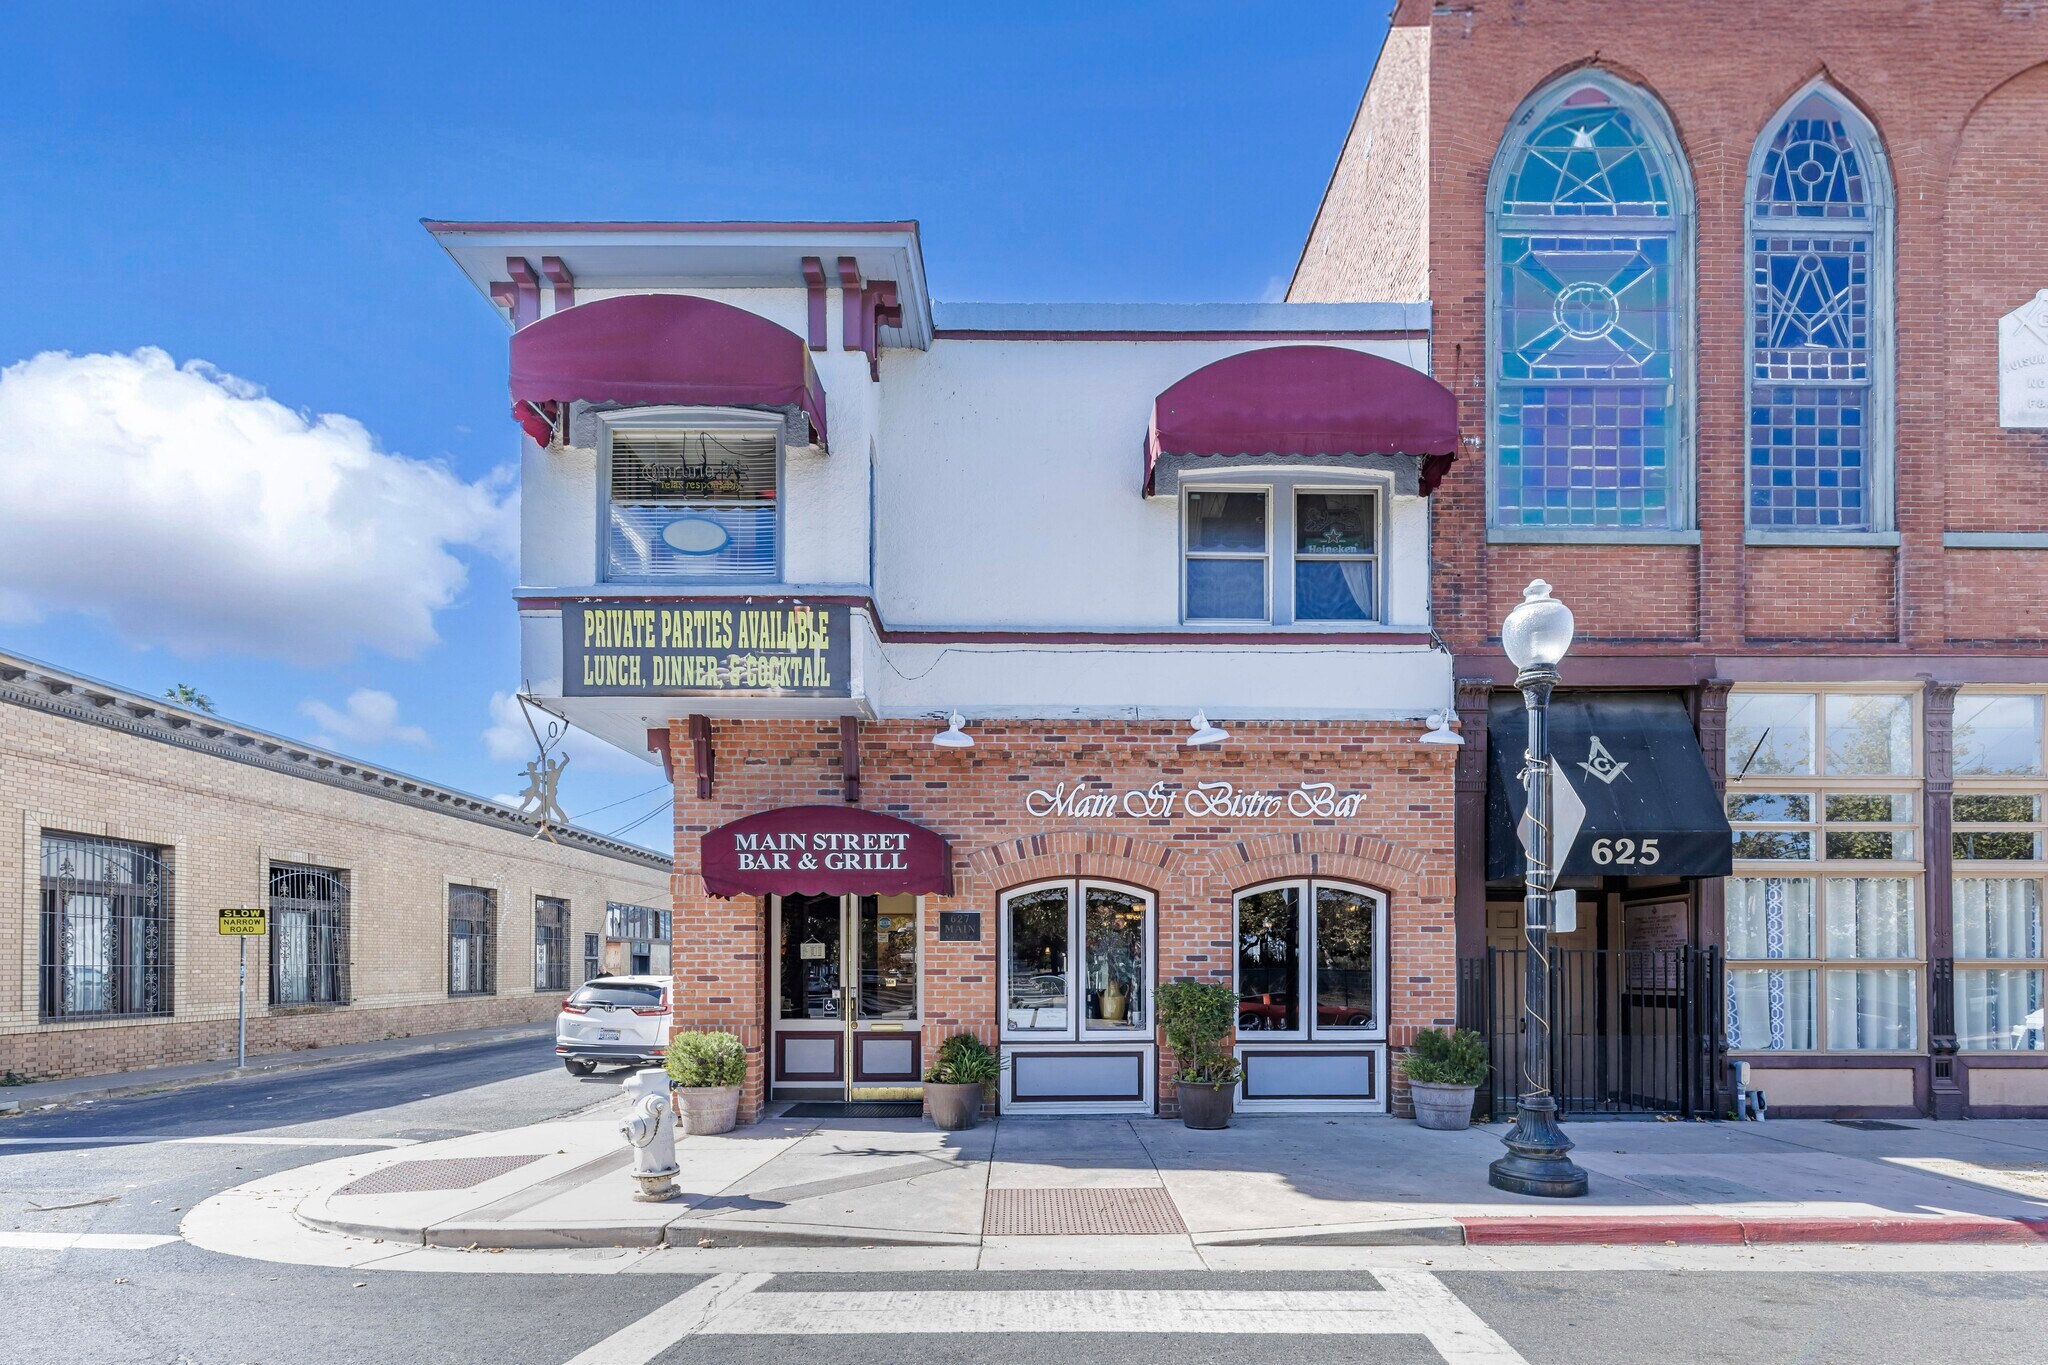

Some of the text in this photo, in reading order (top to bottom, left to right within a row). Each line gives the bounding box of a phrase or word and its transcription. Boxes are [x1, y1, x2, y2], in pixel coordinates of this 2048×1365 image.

[661, 480, 684, 489] relax
[1308, 545, 1357, 553] Heineken
[584, 609, 830, 650] PRIVATE PARTIES AVAILABLE
[583, 655, 831, 689] LUNCH, DINNER, & COCKTAIL
[1025, 780, 1367, 818] Main St Bistro Bar
[734, 833, 910, 851] MAIN STREET
[1591, 838, 1660, 866] 625
[738, 853, 908, 870] BAR & GRILL
[950, 914, 970, 923] 627
[944, 924, 976, 933] MAIN
